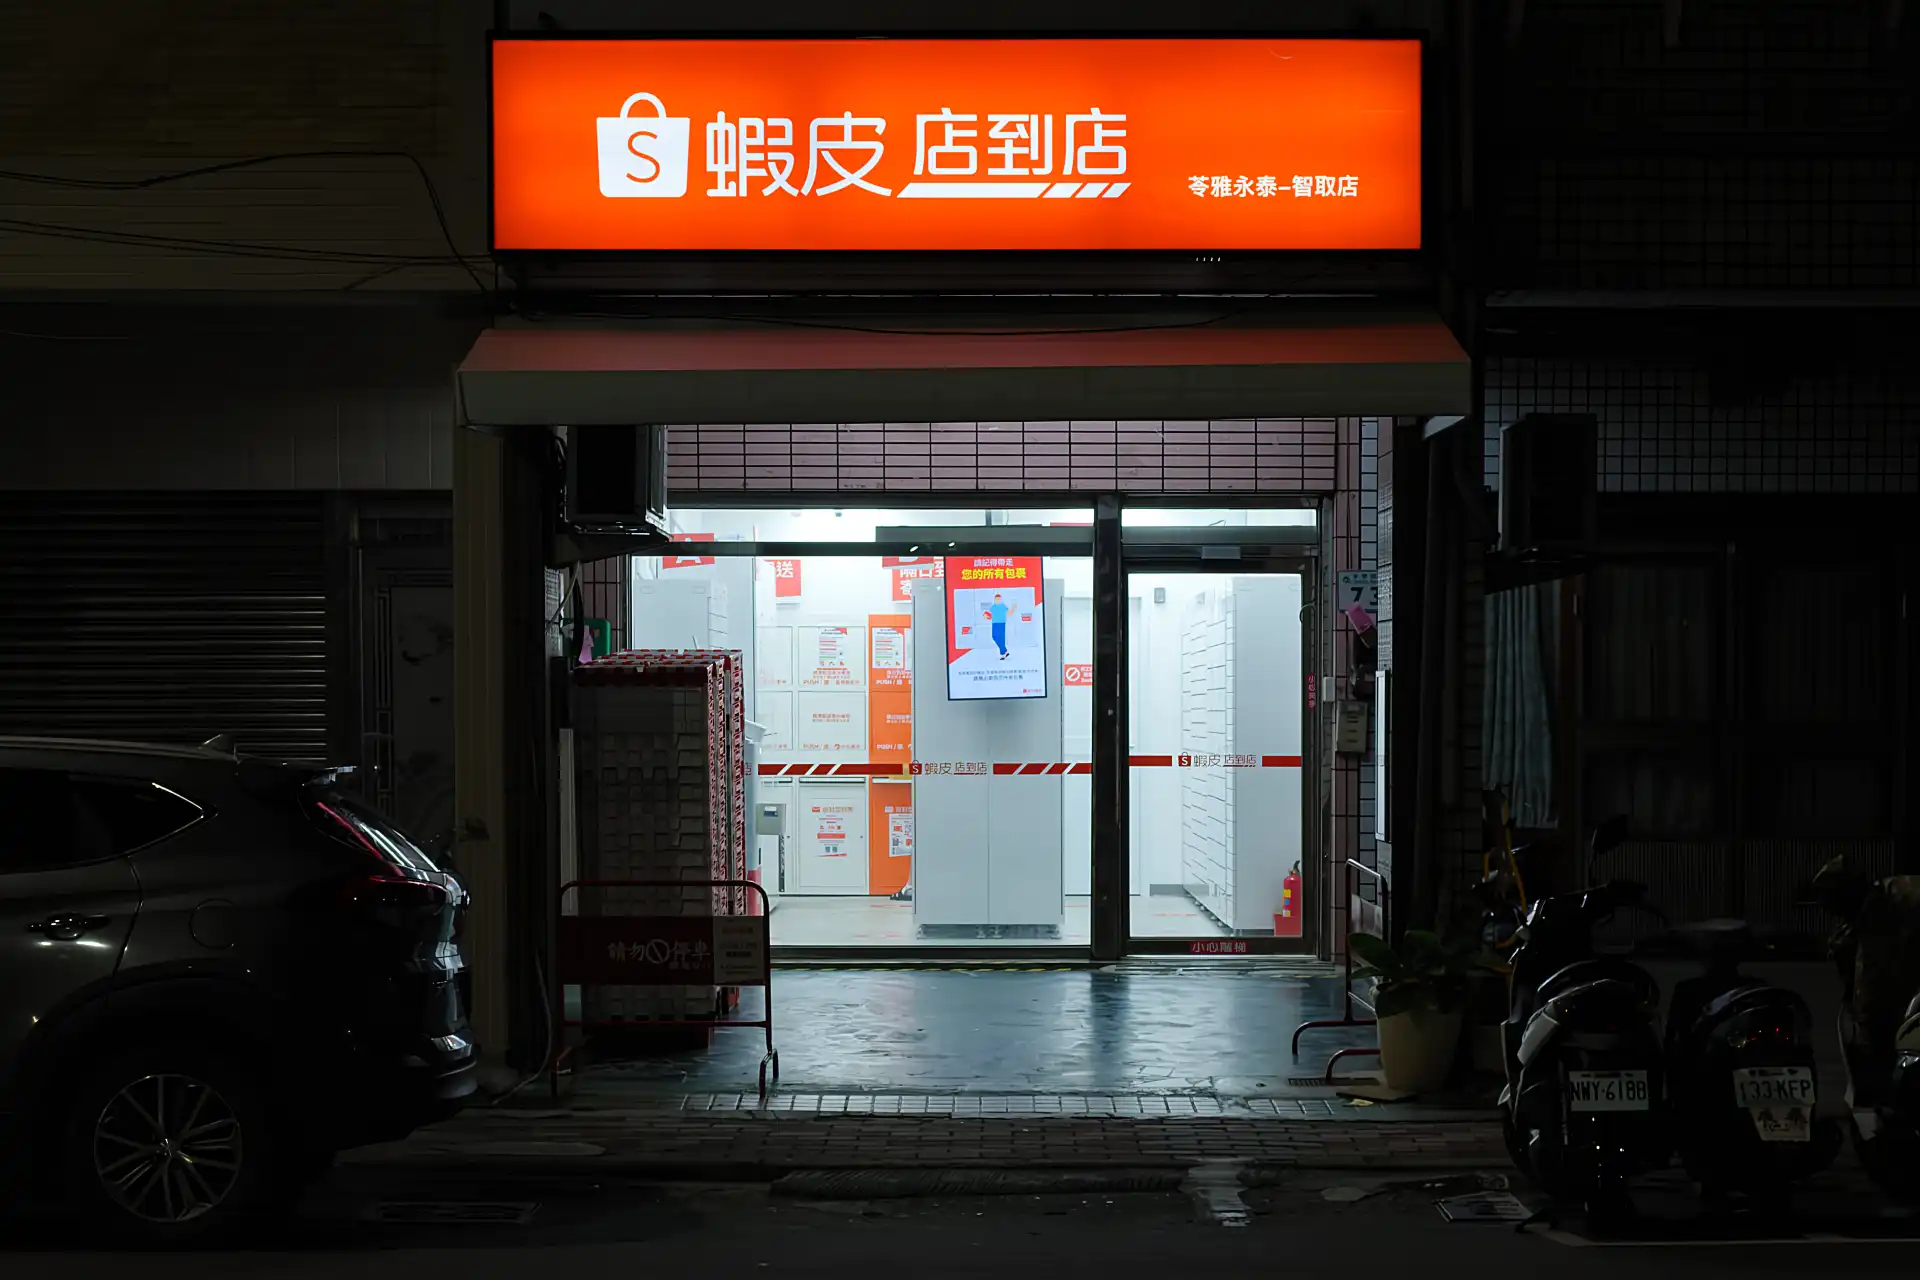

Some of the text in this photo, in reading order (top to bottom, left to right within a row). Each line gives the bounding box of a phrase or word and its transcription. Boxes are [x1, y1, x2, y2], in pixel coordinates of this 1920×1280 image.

[626, 131, 660, 183] S
[706, 107, 1127, 197] 蝦皮 店到店
[961, 567, 1027, 580] 您的所有包裹
[1193, 754, 1257, 767] 蝦皮 店到店
[924, 761, 987, 775] 蝦皮 店到店
